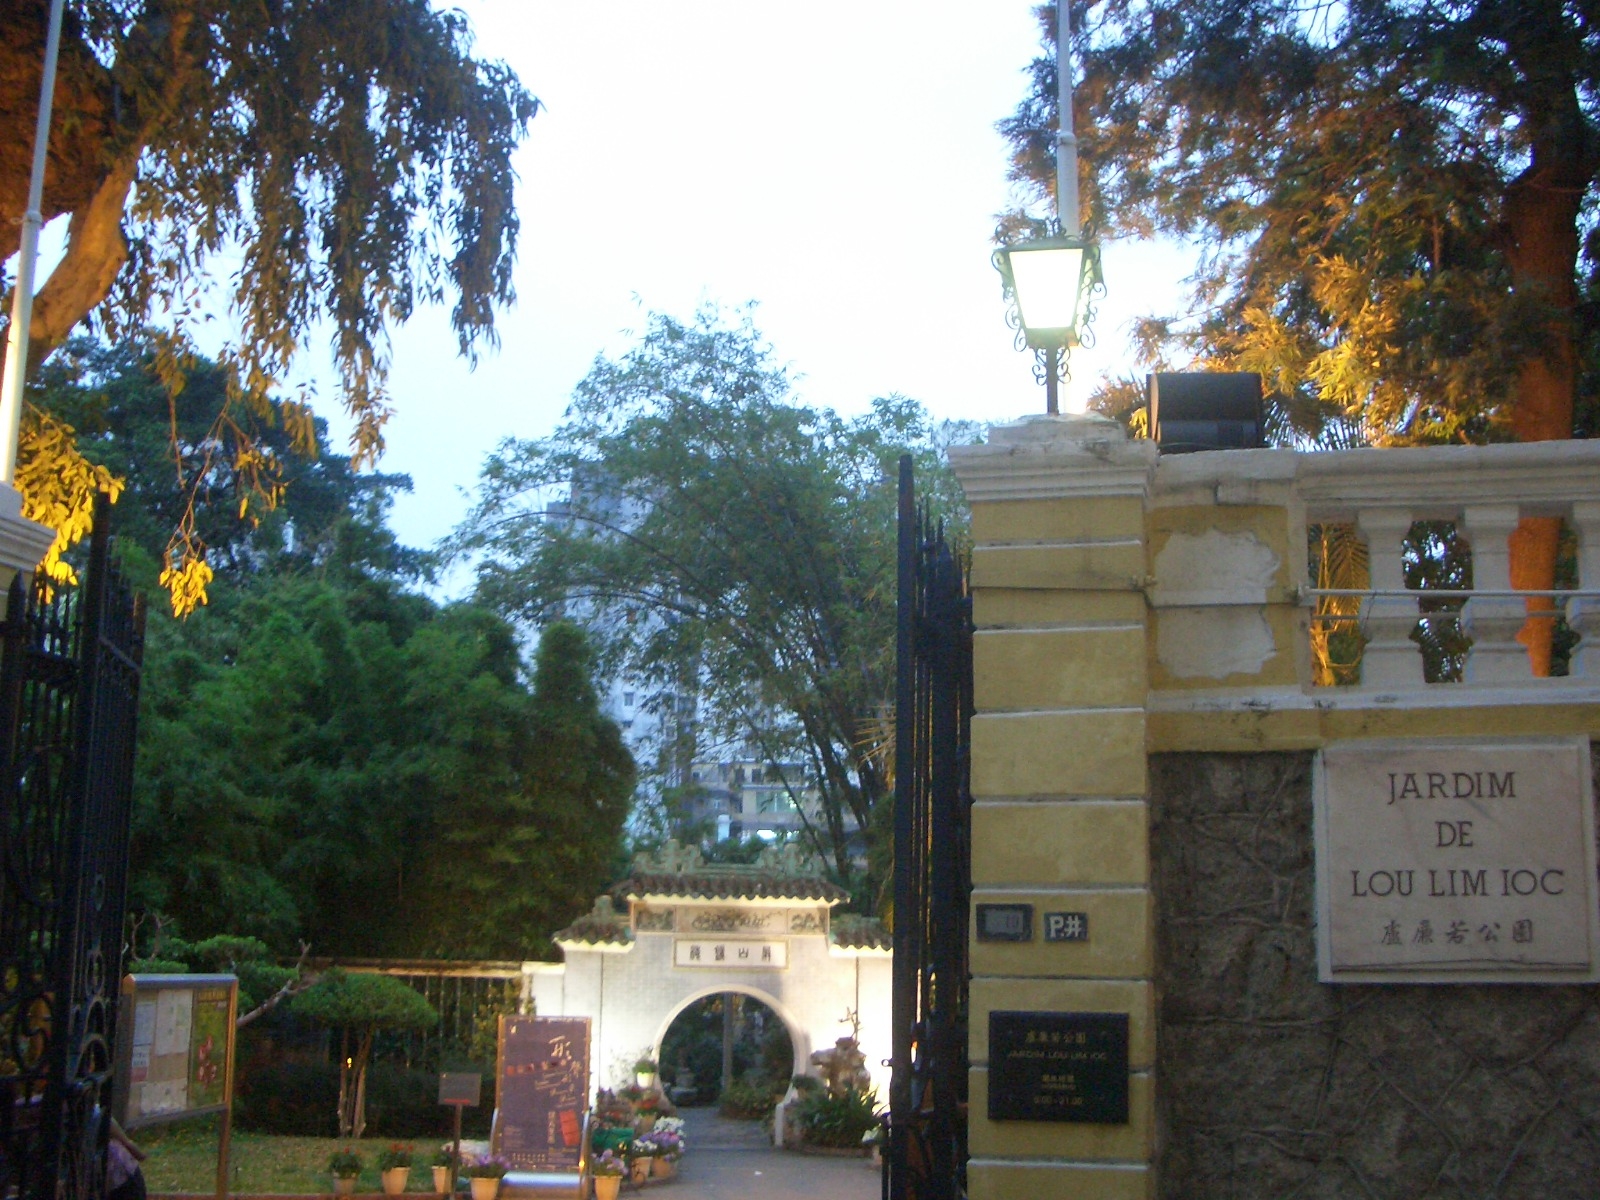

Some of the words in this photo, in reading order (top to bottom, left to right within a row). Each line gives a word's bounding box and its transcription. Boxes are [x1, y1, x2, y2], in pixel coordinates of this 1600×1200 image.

[1387, 772, 1516, 805] JARDIM
[1435, 821, 1474, 848] DE
[1351, 869, 1415, 898] LOU
[1428, 869, 1490, 897] LIM
[1501, 869, 1565, 896] IOC
